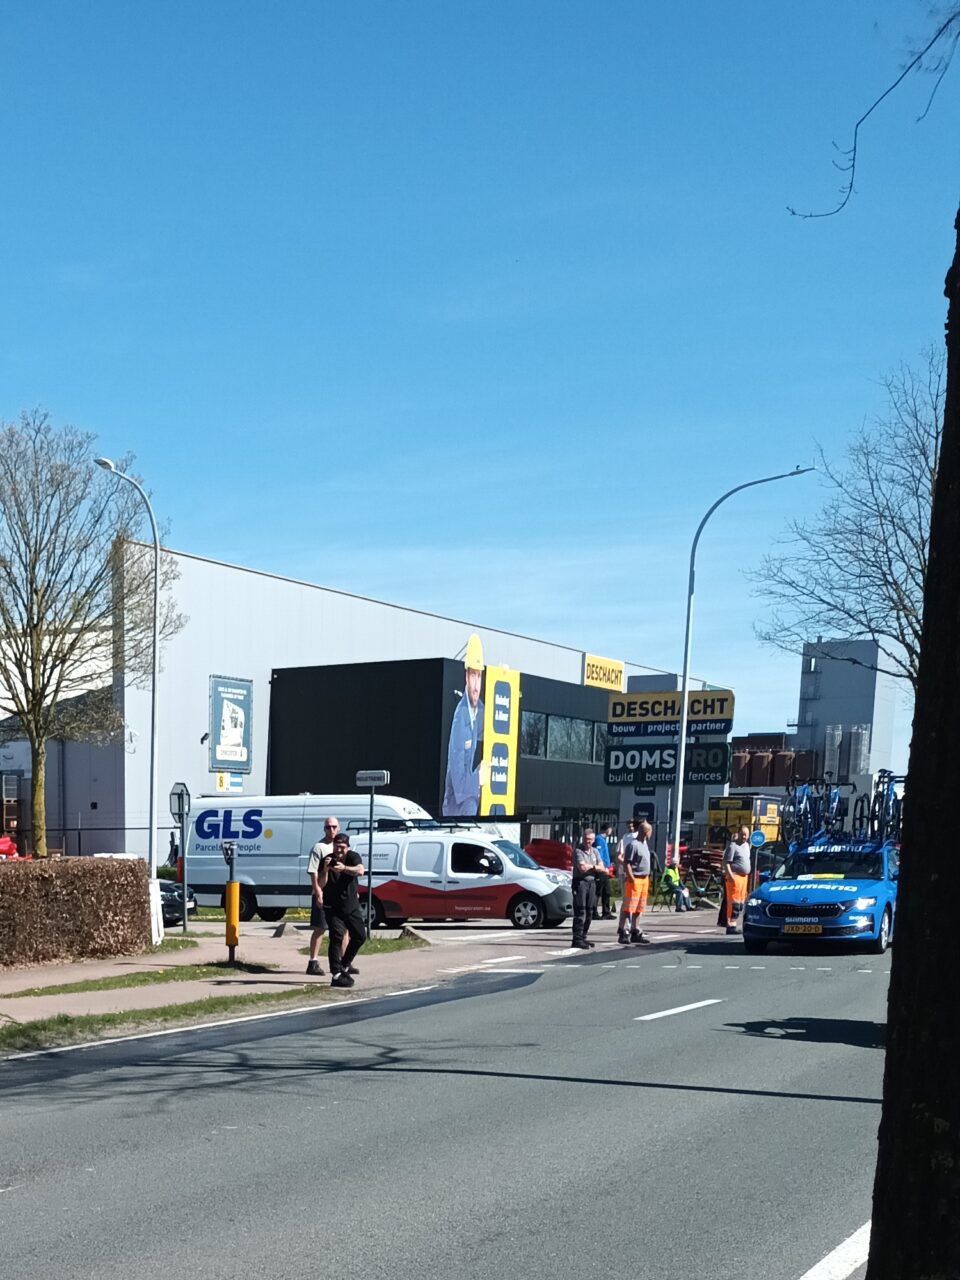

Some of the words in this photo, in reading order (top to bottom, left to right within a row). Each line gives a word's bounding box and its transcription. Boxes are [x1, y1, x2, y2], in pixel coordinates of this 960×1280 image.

[586, 663, 623, 686] DESCHACHT
[612, 724, 636, 733] bouw
[647, 722, 680, 733] project
[690, 721, 726, 732] partner
[608, 773, 634, 782] build
[645, 772, 676, 781] better
[688, 771, 722, 781] fences
[195, 843, 223, 851] Parcels
[769, 883, 858, 893] SHIMANO
